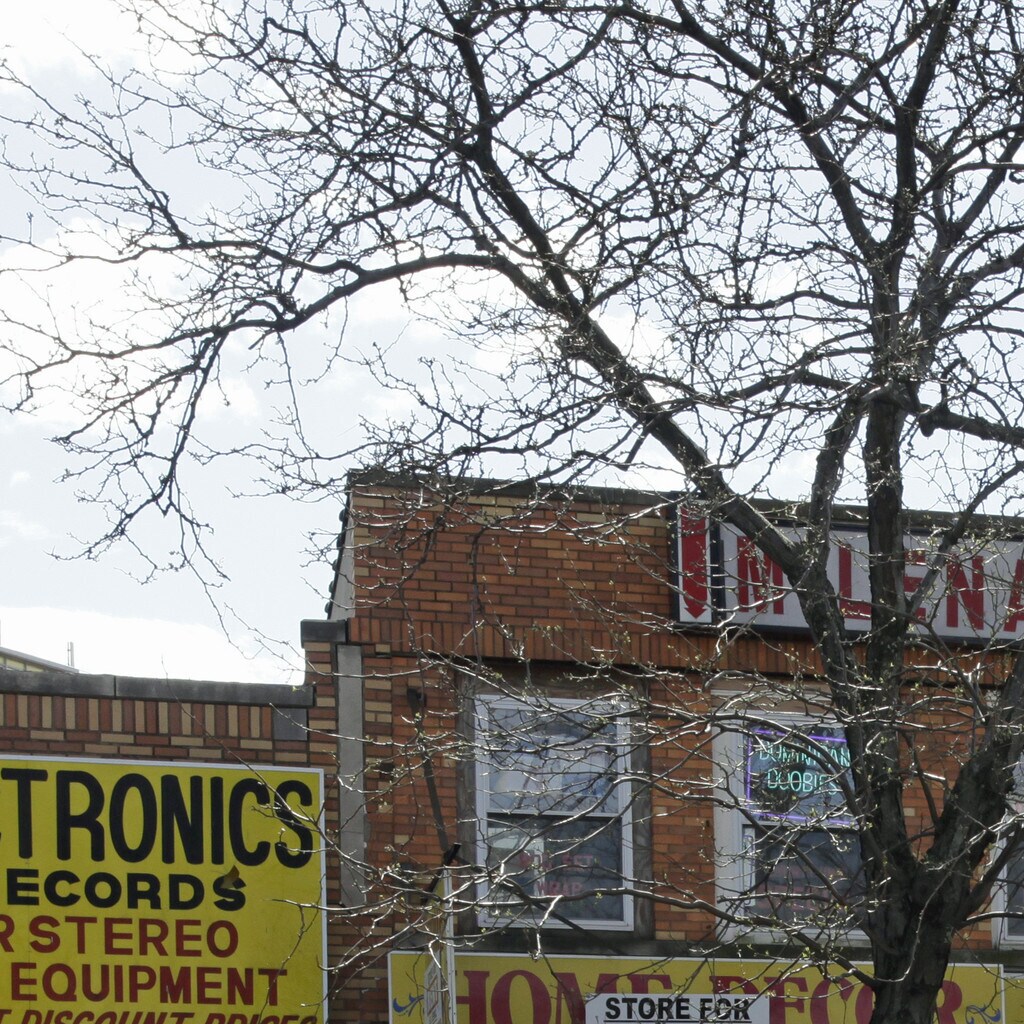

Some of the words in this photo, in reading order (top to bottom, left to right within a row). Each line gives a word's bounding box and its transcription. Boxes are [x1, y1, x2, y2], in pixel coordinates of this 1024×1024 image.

[0, 767, 314, 869] TRONICS
[29, 915, 240, 958] STEREO
[11, 961, 288, 1007] EQUIPMENT
[605, 997, 691, 1021] STORE
[700, 998, 750, 1021] FOR
